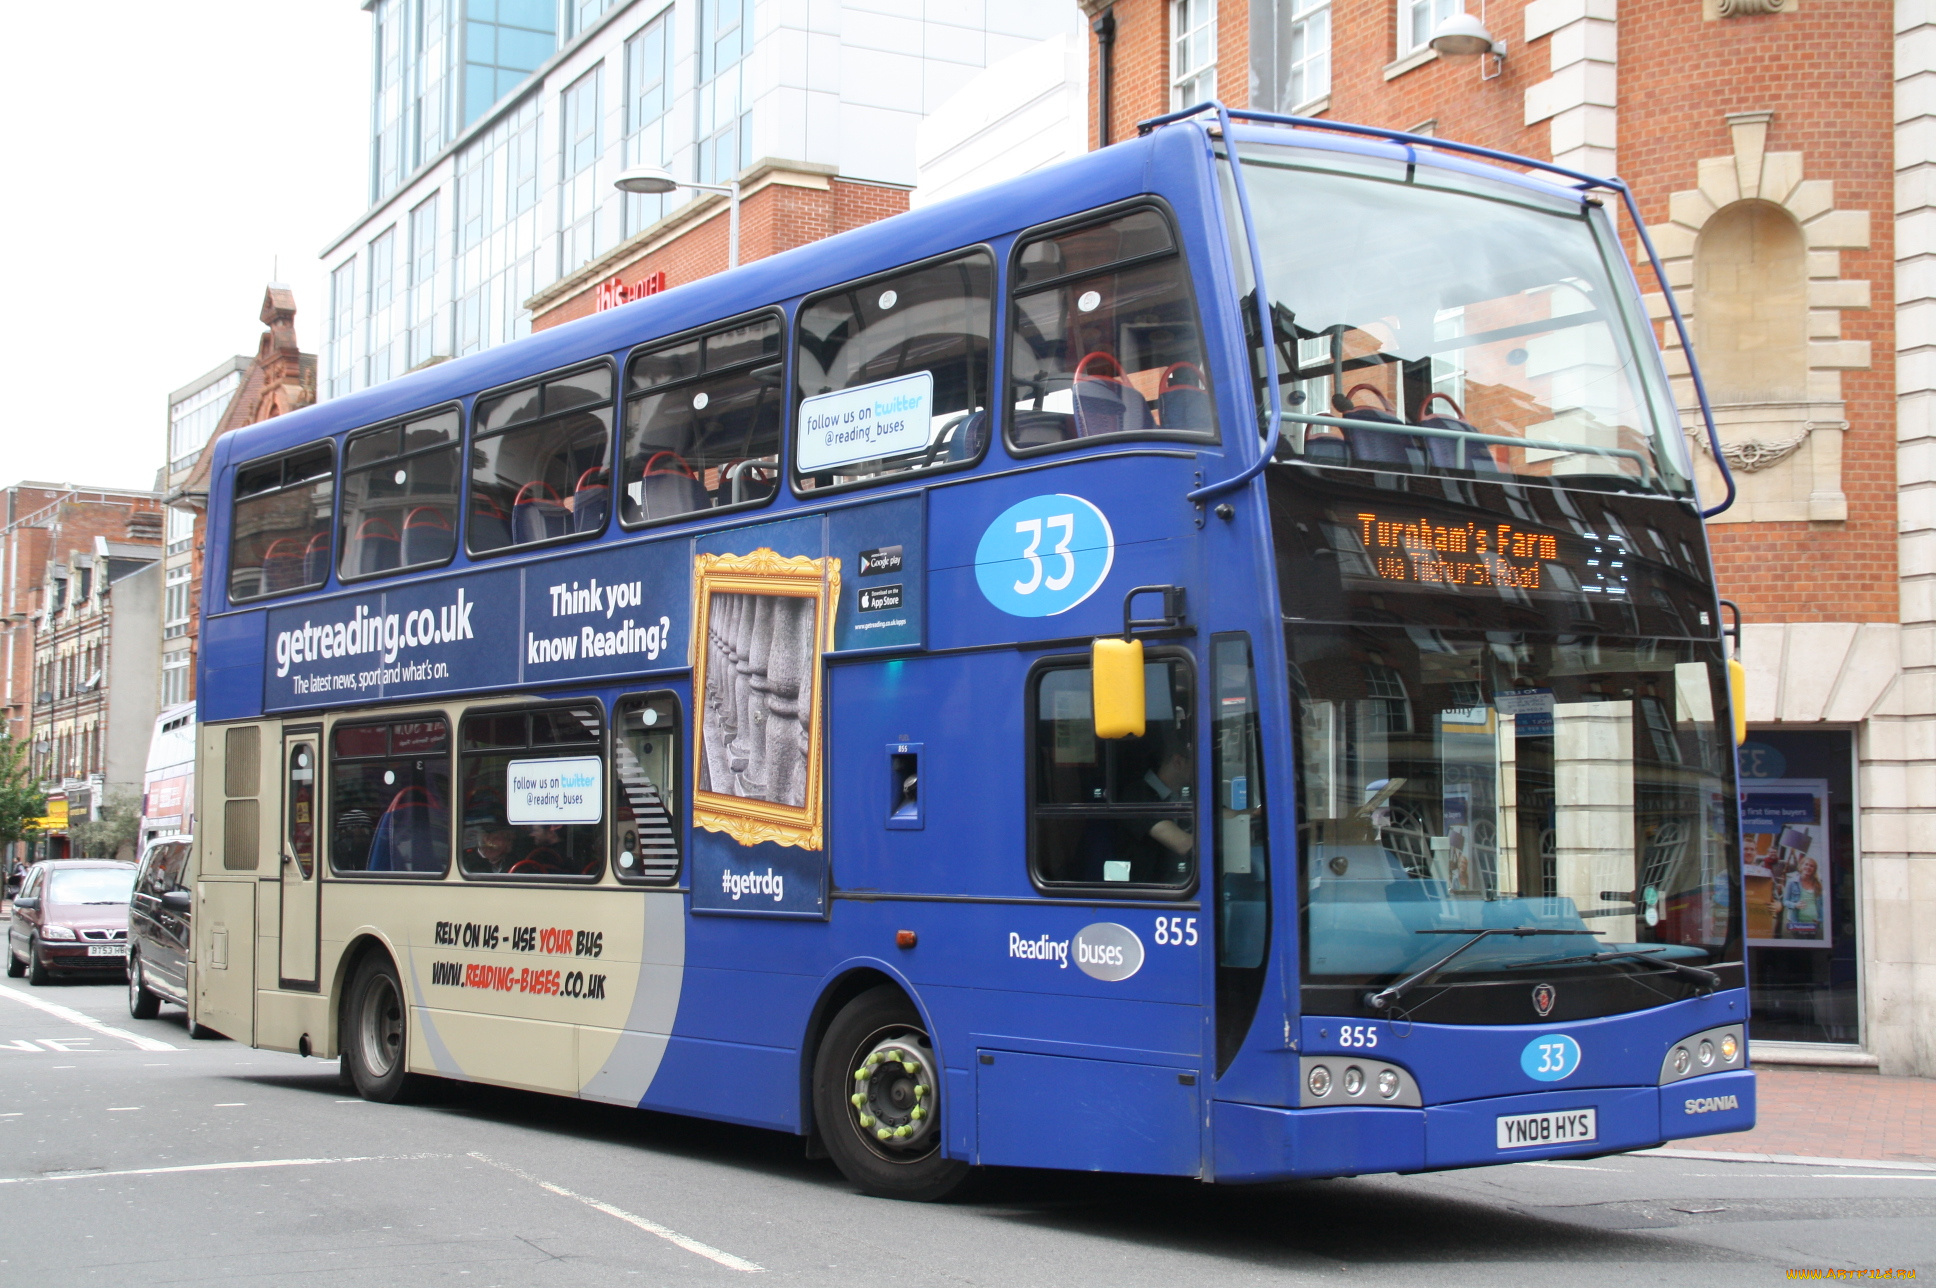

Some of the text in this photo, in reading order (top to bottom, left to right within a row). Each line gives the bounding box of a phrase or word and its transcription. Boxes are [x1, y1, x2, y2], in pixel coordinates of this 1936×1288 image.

[596, 277, 623, 312] ibis
[807, 395, 923, 435] follow us on twitter
[825, 420, 904, 446] @reading_buses
[1358, 513, 1556, 559] Turnham's Farm
[870, 556, 889, 569] Google
[890, 555, 901, 566] play
[1013, 513, 1075, 595] 33
[1378, 551, 1404, 579] via
[1496, 559, 1539, 588] Road
[550, 578, 642, 619] Think you
[871, 596, 899, 609] App Store
[276, 587, 475, 677] getreading.co.uk
[528, 616, 670, 664] know Reading?
[293, 659, 449, 694] The latest news, sport and what's on.
[513, 773, 595, 793] follow us on twitter
[527, 792, 583, 809] @reading_buses
[722, 868, 783, 902] #getrdg
[435, 921, 462, 945] RELY
[463, 922, 481, 948] ON
[483, 924, 499, 949] US
[512, 926, 537, 951] USE
[539, 927, 573, 954] YOUR
[575, 930, 603, 958] BUS
[1154, 916, 1198, 946] 855
[1009, 931, 1123, 969] Reading buses
[432, 960, 607, 1000] WWW.READING-BUSES.CO.UK
[1339, 1025, 1377, 1047] 855
[1537, 1043, 1564, 1073] 33
[1684, 1094, 1739, 1115] SCANIA
[1505, 1114, 1589, 1143] YN08 HYS
